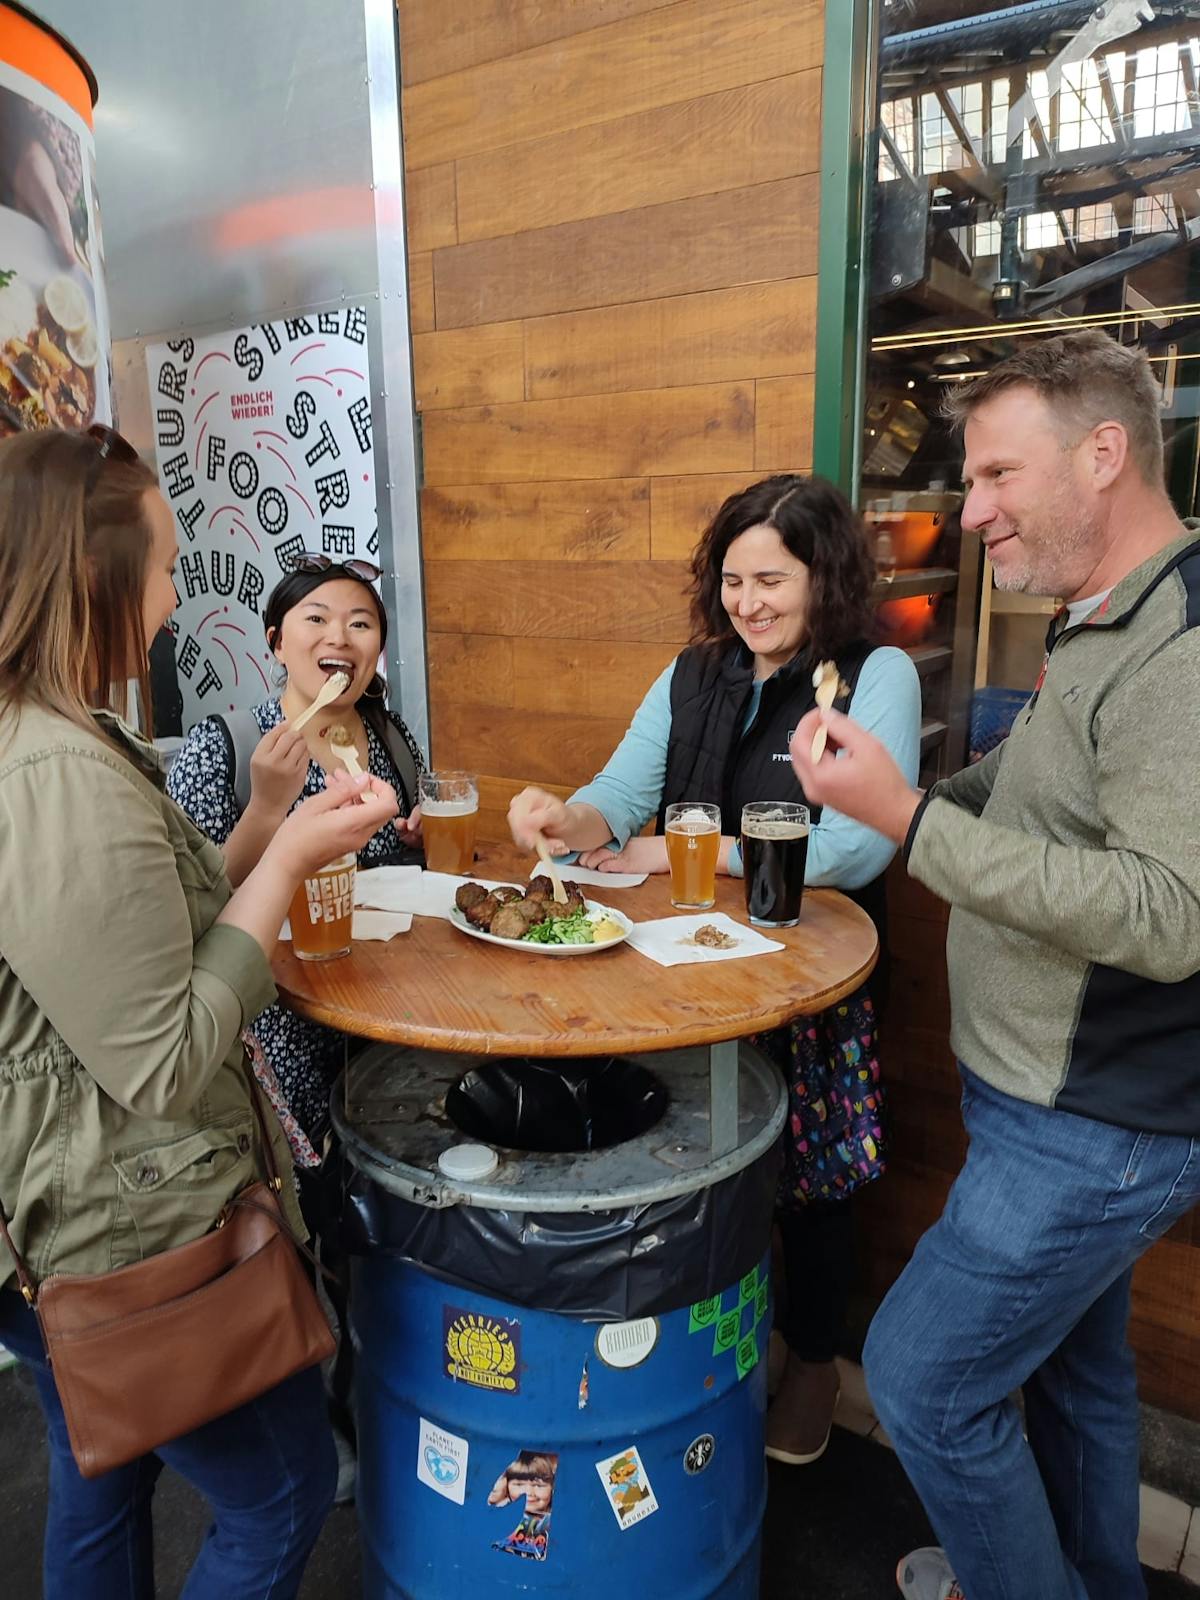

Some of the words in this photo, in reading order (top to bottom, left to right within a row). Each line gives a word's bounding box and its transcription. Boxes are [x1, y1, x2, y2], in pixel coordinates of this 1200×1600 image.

[230, 390, 273, 406] ENDLICH
[231, 405, 274, 420] WIEDER!
[453, 1313, 509, 1341] FERRIES
